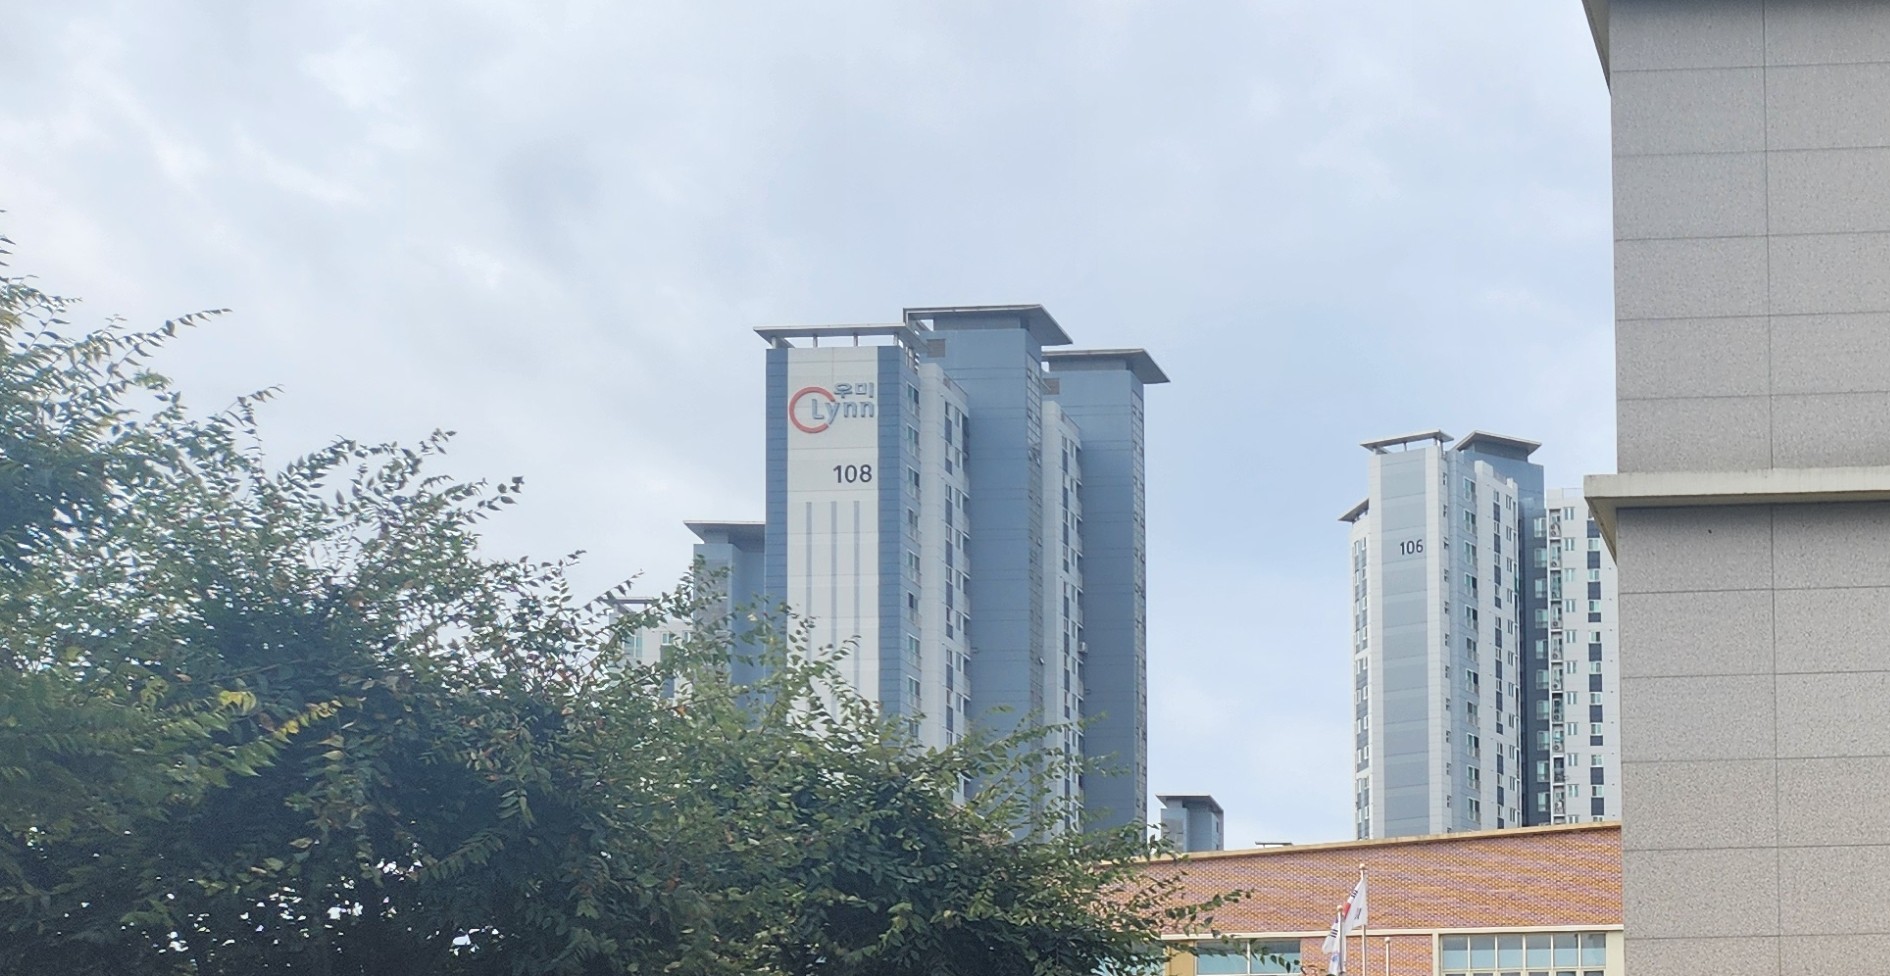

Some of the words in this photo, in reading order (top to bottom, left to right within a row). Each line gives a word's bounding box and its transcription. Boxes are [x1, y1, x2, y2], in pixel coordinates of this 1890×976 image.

[833, 382, 874, 398] 우미
[811, 399, 875, 425] Lynn
[833, 464, 872, 483] 108
[1400, 539, 1423, 555] 106
